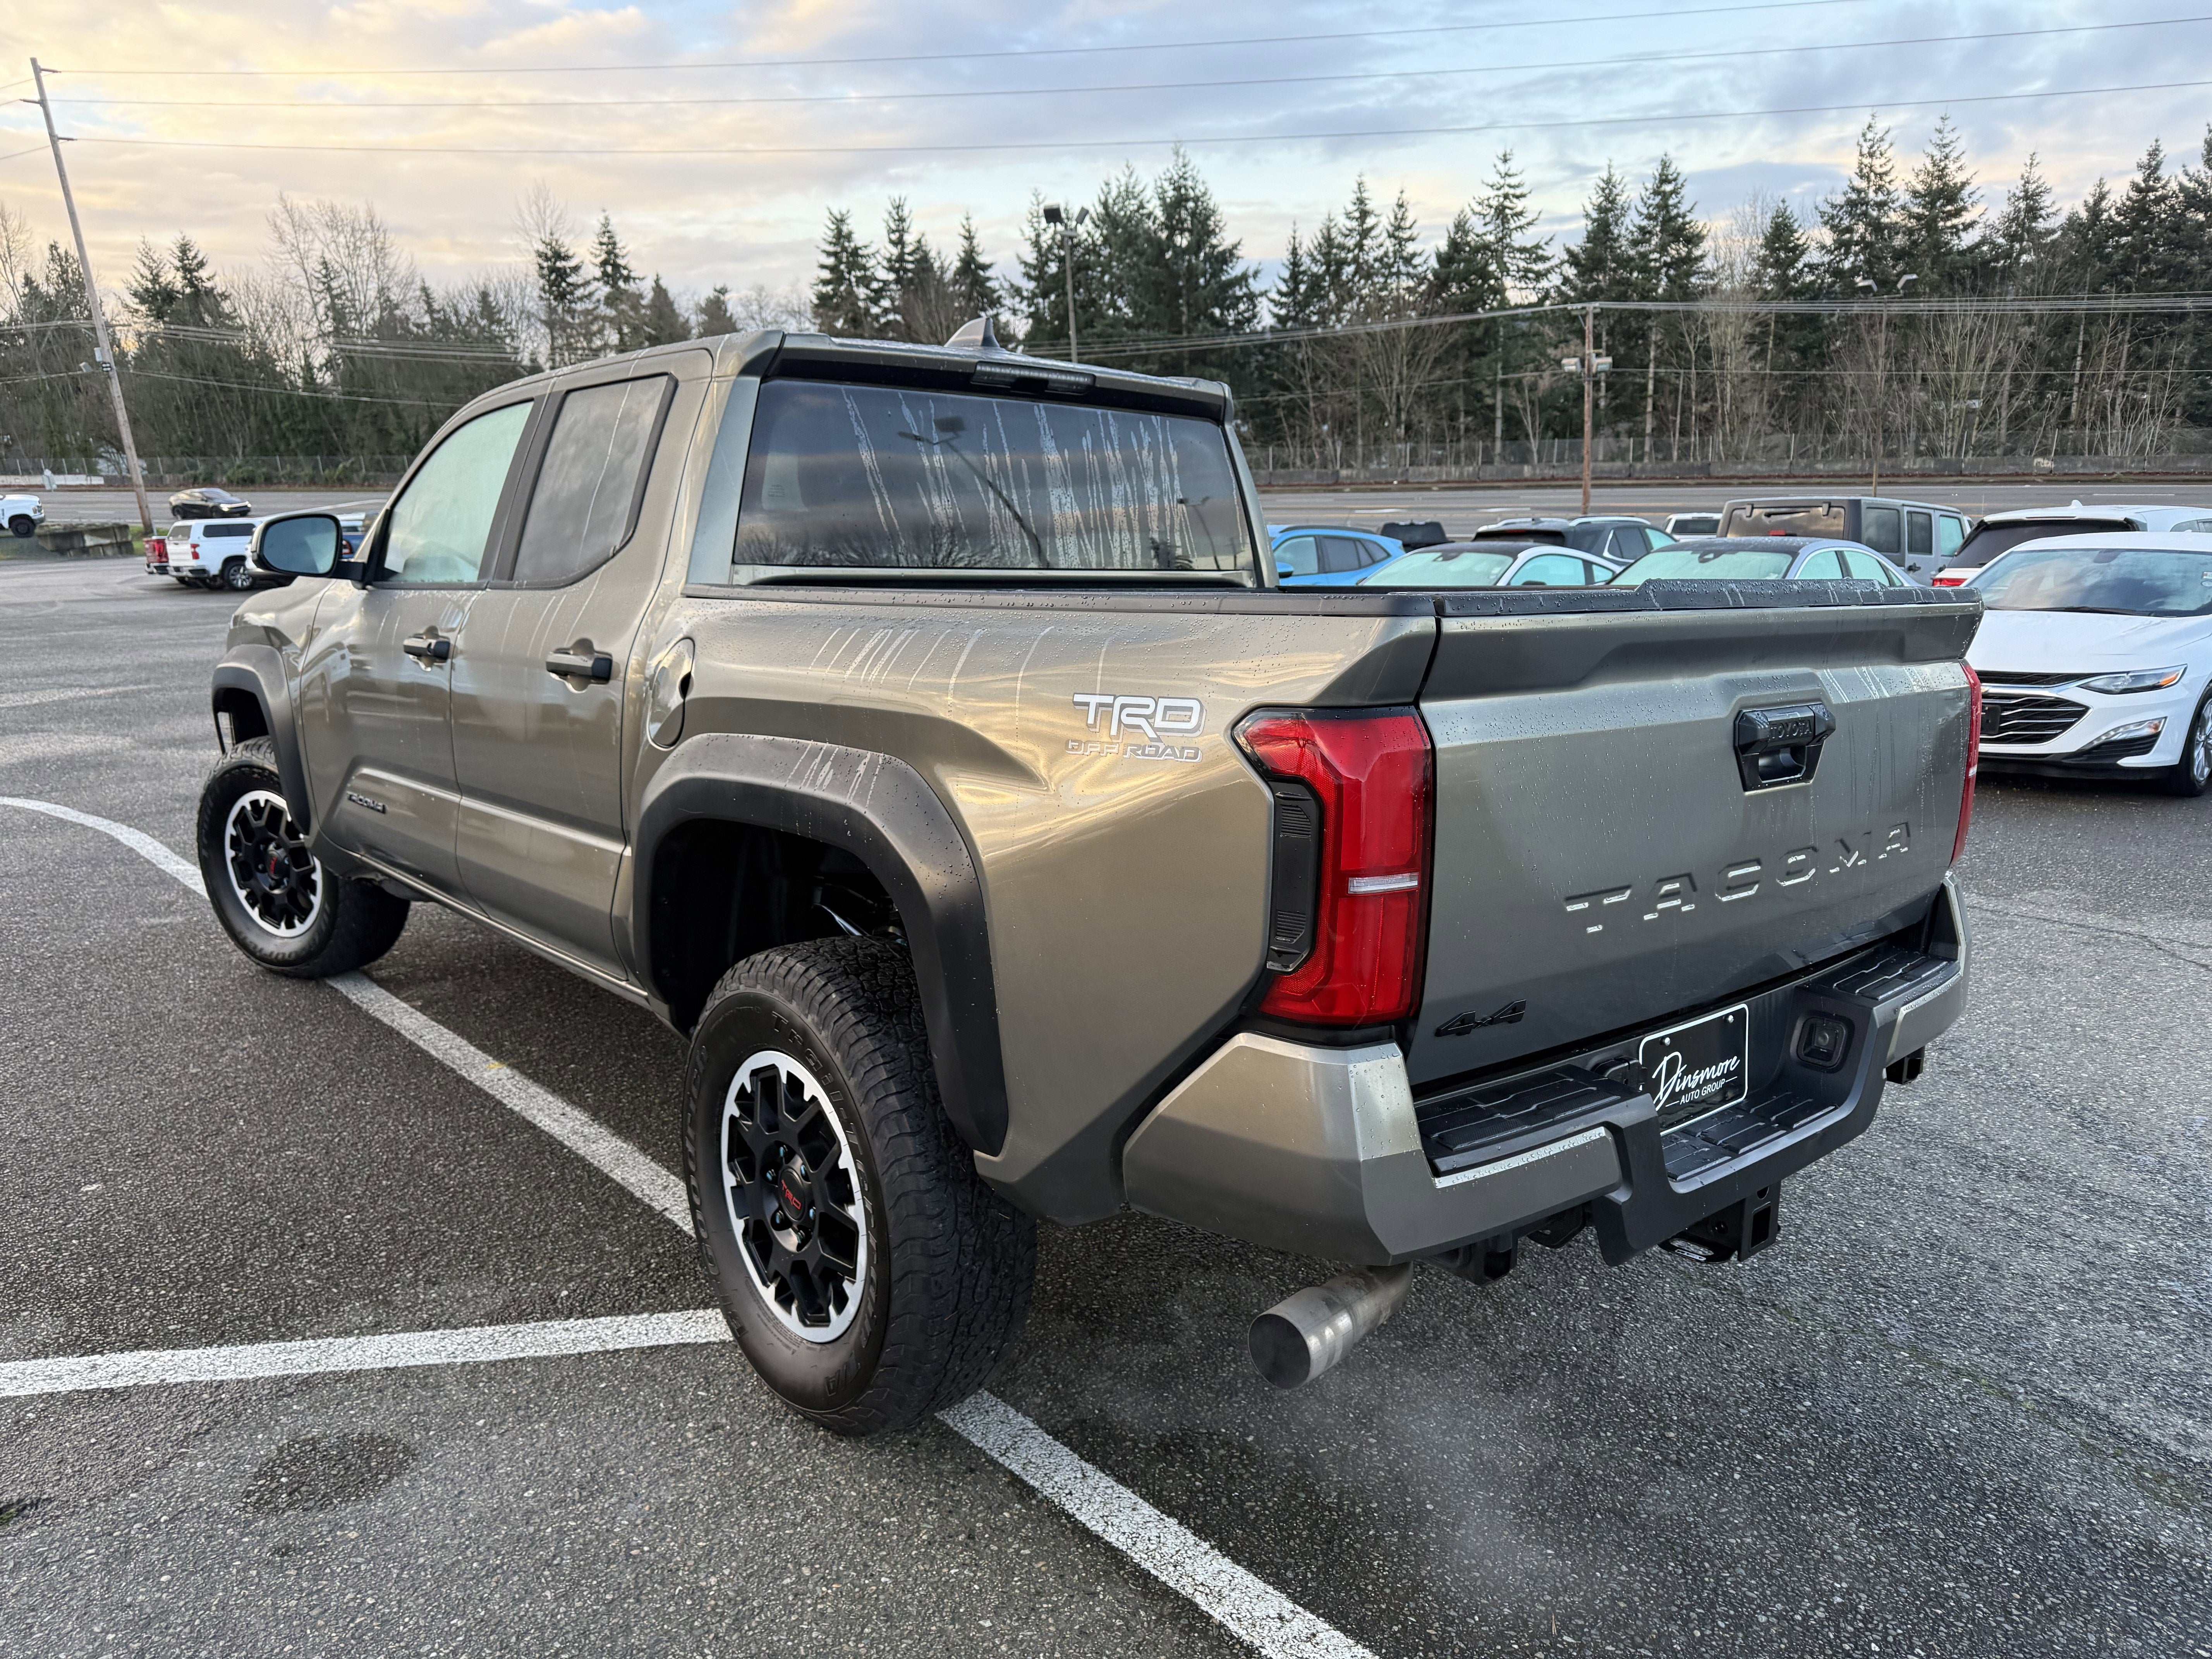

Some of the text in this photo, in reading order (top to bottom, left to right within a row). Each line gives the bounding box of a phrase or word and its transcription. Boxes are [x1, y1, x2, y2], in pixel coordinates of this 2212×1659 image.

[1073, 693, 1204, 740] TRD
[1770, 720, 1812, 738] TOYOTA
[1065, 739, 1203, 763] OFF ROAD
[1564, 822, 1910, 933] TACOMA
[1652, 1051, 1740, 1111] Dinsmore
[1680, 1078, 1725, 1105] AUTO GROUP
